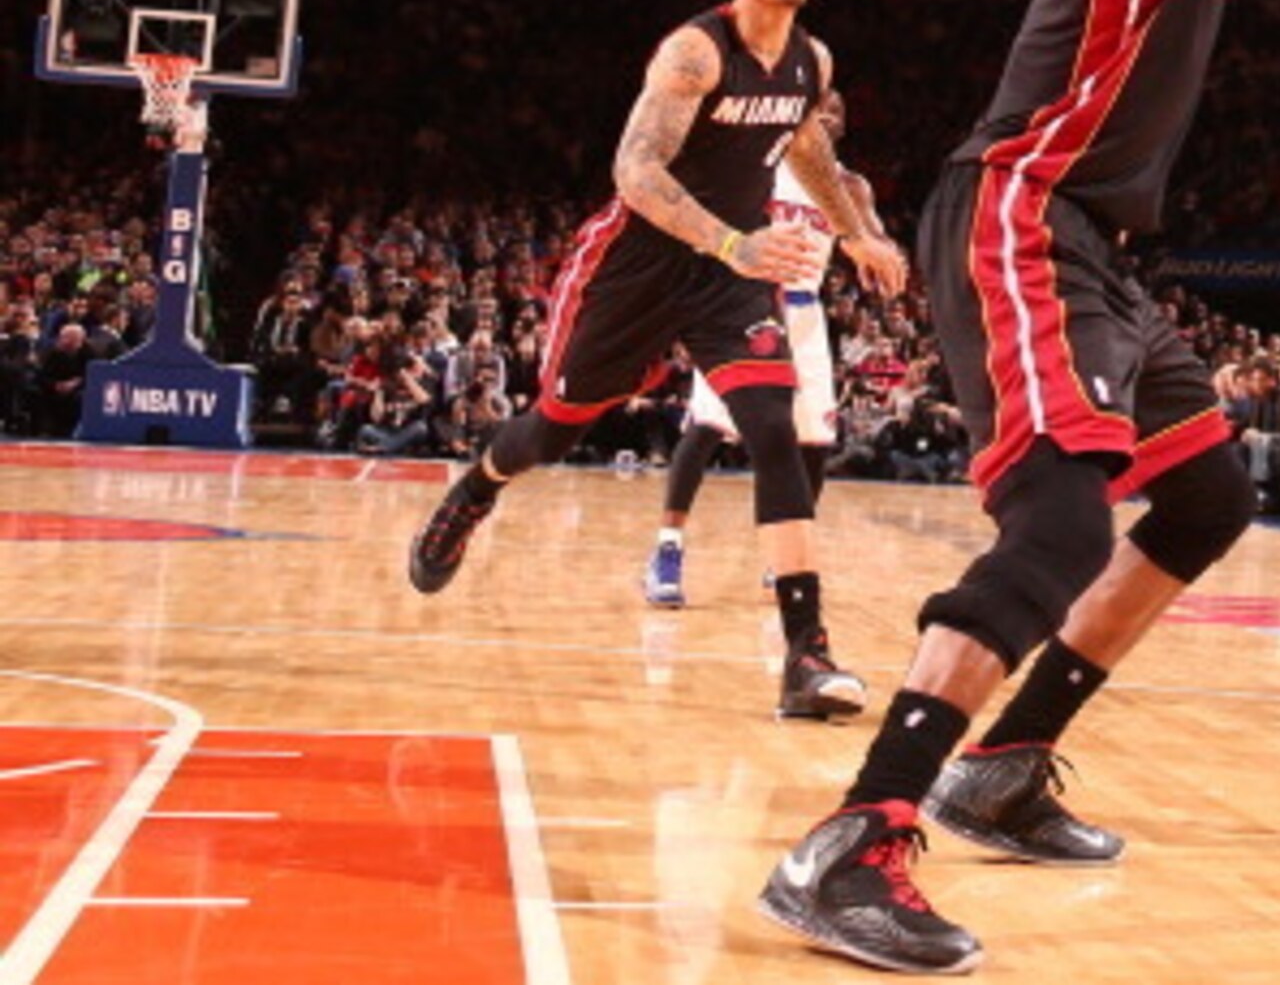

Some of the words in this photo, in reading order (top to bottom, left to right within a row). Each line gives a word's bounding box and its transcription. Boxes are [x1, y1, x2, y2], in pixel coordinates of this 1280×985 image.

[710, 95, 807, 124] MIAMI
[130, 388, 181, 414] NBA
[184, 390, 217, 417] TV
